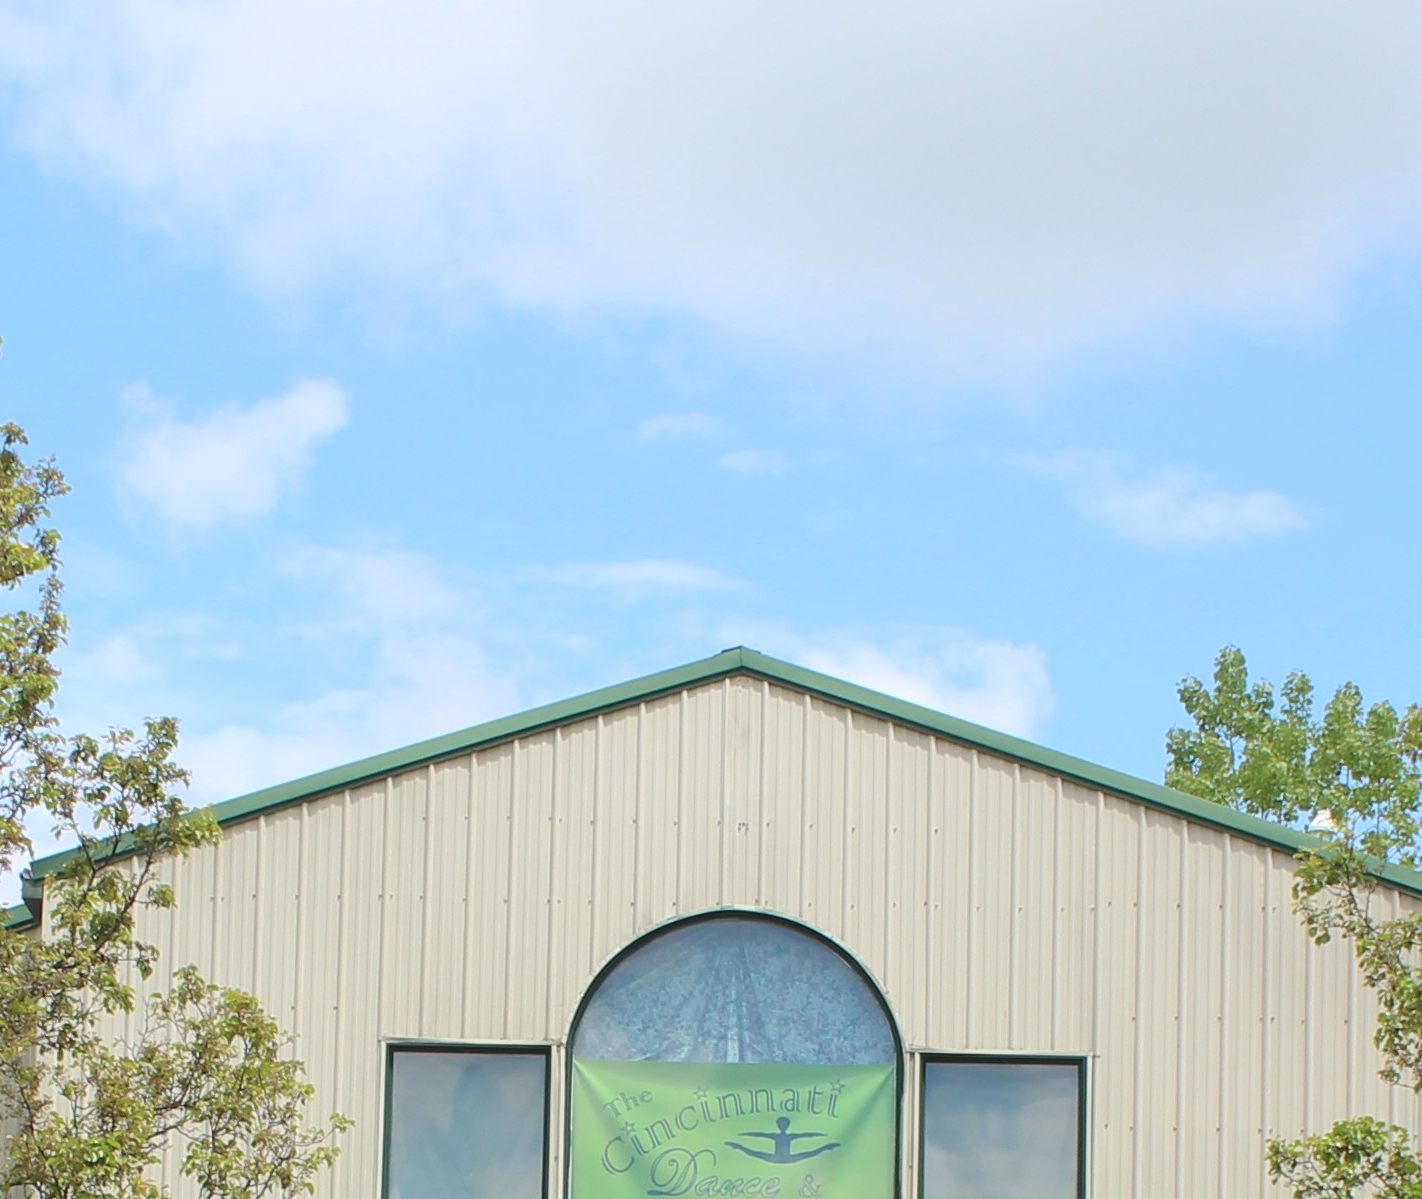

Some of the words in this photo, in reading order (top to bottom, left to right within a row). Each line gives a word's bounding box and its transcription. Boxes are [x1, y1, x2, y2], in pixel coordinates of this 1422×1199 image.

[601, 1079, 845, 1176] Cincinnati
[604, 1087, 653, 1119] The
[647, 1147, 781, 1198] Dance
[798, 1174, 822, 1199] &
